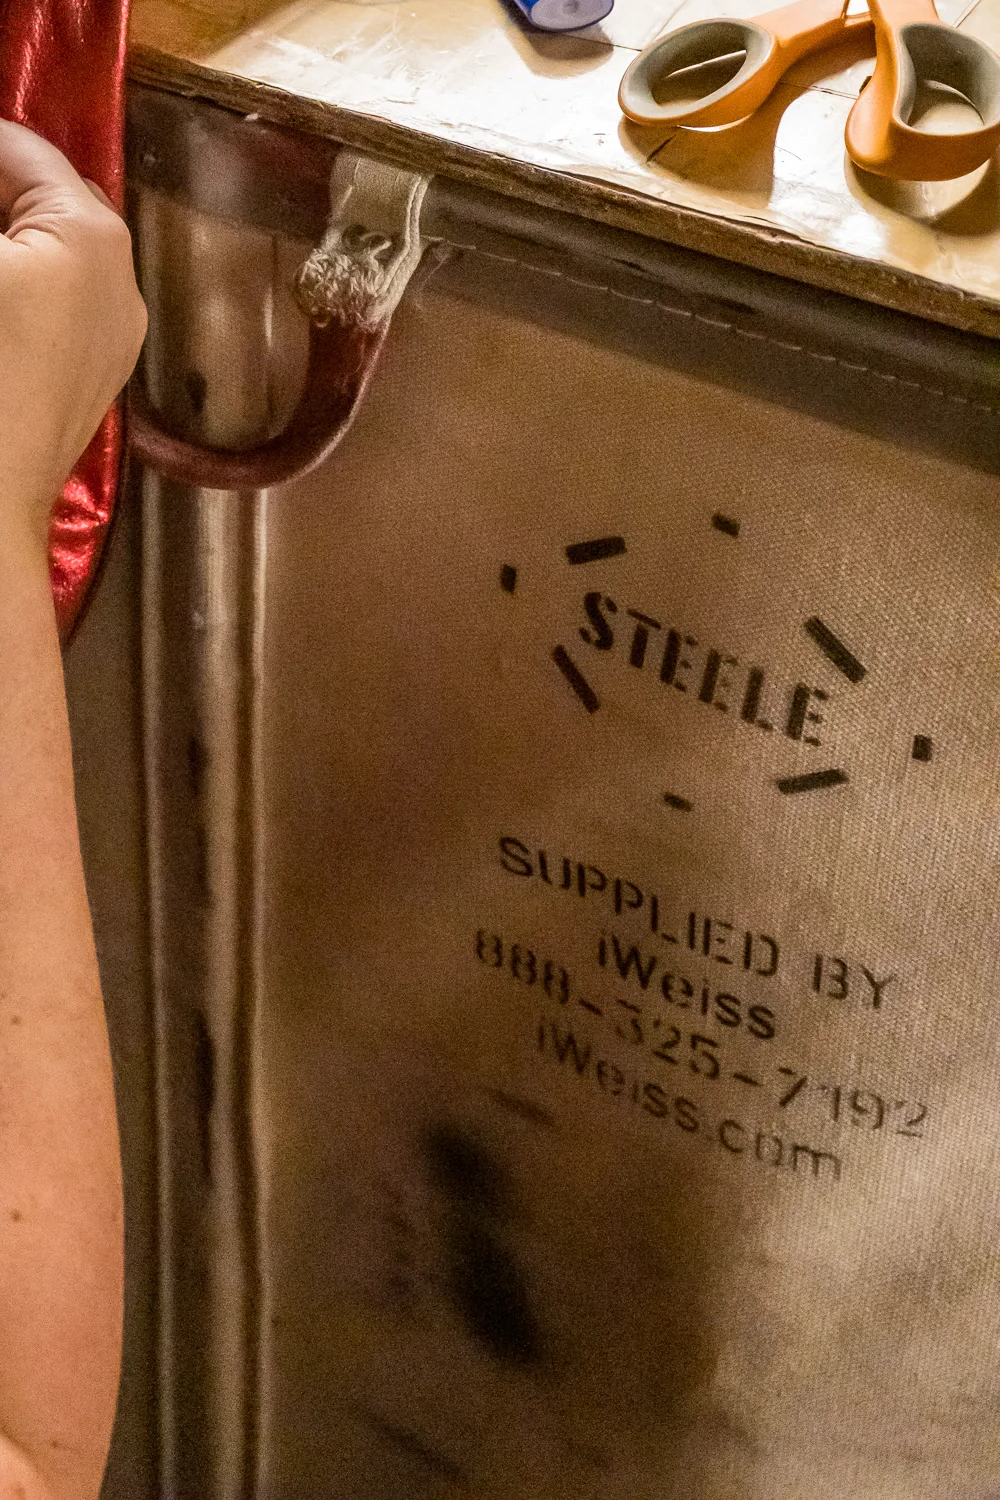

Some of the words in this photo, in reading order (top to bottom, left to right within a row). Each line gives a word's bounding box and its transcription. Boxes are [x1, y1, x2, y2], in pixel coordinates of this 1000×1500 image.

[577, 590, 831, 748] STEELE
[499, 835, 781, 978] SUPPLIED
[812, 953, 897, 1010] BY
[599, 933, 776, 1041] iWeiss
[475, 929, 929, 1140] 888-325-7192
[537, 1014, 843, 1182] iWeiss.com
